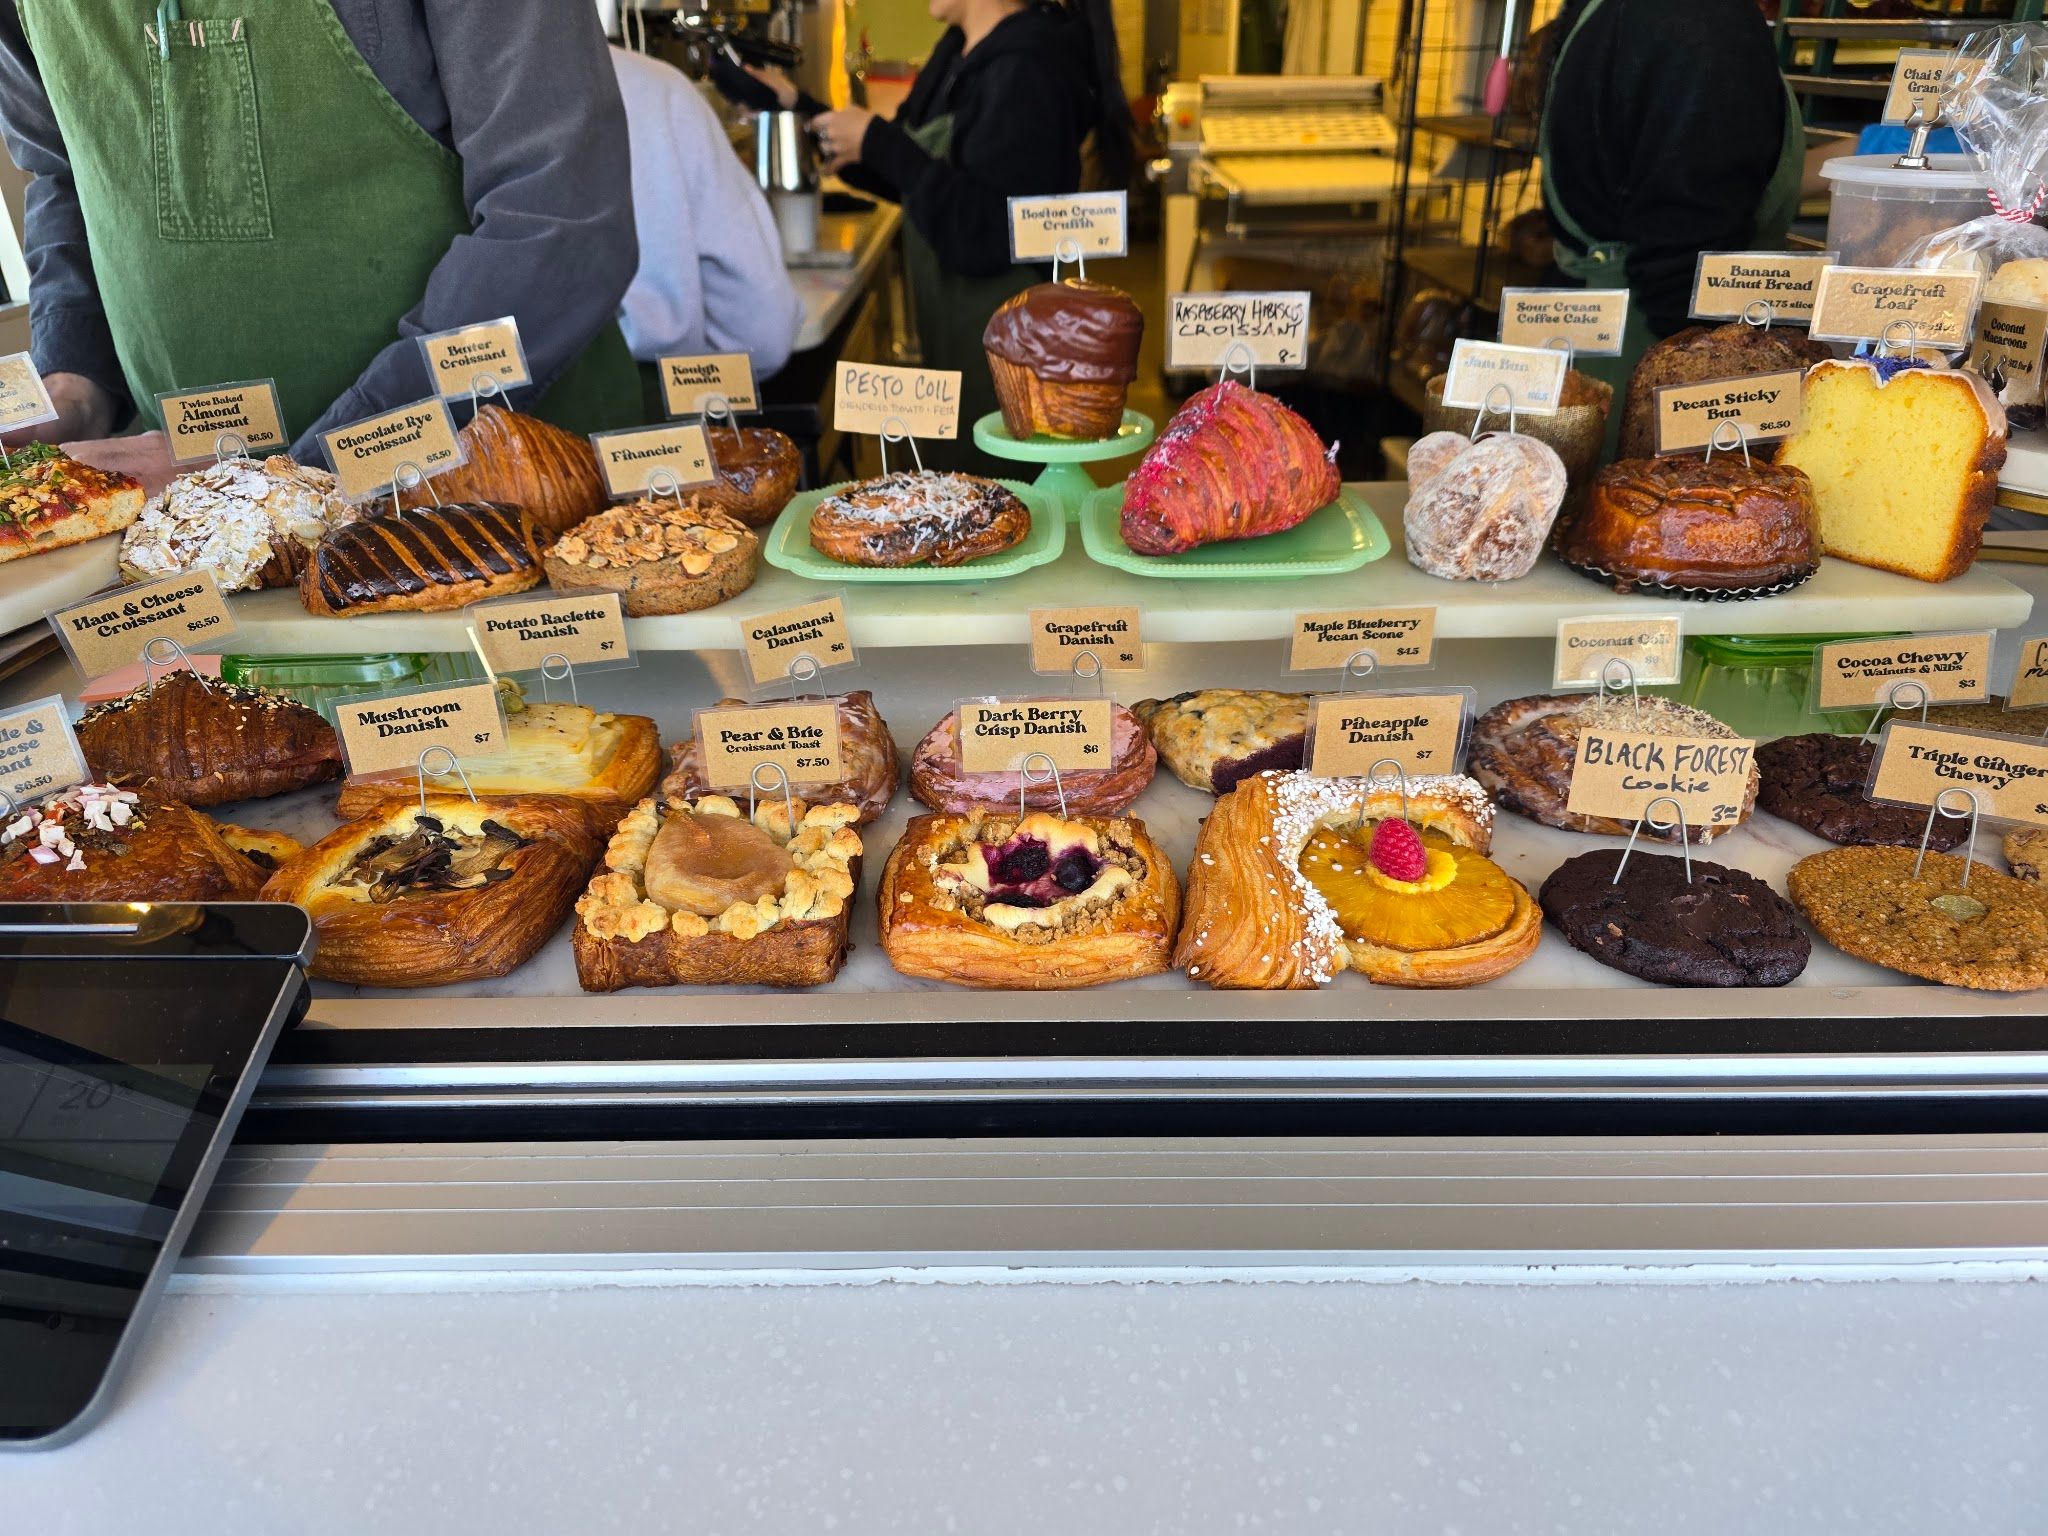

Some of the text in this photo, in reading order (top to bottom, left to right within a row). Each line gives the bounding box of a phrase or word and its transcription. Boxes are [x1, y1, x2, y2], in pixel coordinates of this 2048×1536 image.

[1903, 68, 1932, 80] Chai
[1021, 205, 1117, 220] Boston Cream
[1043, 218, 1094, 231] Cruffin
[1730, 264, 1791, 278] Banana
[1706, 276, 1813, 292] Walnut Bread
[1850, 281, 1947, 299] Grapefruit
[1516, 302, 1602, 313] Sour Cream
[1789, 301, 1814, 309] slice
[1874, 297, 1918, 311] Loaf
[1517, 313, 1599, 324] Coffee Cake
[1990, 318, 2026, 335] Coconut
[1179, 319, 1303, 339] CROISSANT
[1983, 329, 2029, 350] Macaroons
[447, 340, 492, 357] Butter
[440, 348, 507, 370] Croissant
[672, 376, 721, 386] Amann
[845, 369, 953, 402] PESTO COIL
[179, 394, 244, 410] Twice Baked
[1673, 388, 1781, 413] Pecan Sticky
[183, 403, 240, 422] Almond
[1707, 407, 1741, 420] Bun
[178, 416, 249, 435] Croissant
[336, 412, 433, 451] Chocolate Rye
[1759, 419, 1791, 431] $6.50
[247, 432, 273, 443] $6.50
[354, 428, 423, 459] Croissant
[426, 449, 452, 464] $5.50
[611, 444, 683, 464] Financier
[693, 459, 705, 468] $7
[72, 584, 204, 631] Ham & Cheese
[97, 602, 187, 637] Croissant
[187, 615, 221, 632] $6.50
[486, 608, 606, 632] Potato Raclette
[752, 612, 835, 641] Calamansi
[1045, 619, 1129, 635] Grapefruit
[1303, 618, 1421, 634] Maple Blueberry
[518, 624, 580, 641] Danish
[767, 628, 824, 650] Danish
[1059, 633, 1115, 646] Danish
[1317, 629, 1404, 642] Pecan Scone
[600, 641, 614, 651] $7
[830, 643, 845, 653] $6
[1568, 635, 1634, 648] Coconut
[1120, 653, 1133, 662] $6
[1837, 651, 1969, 669] Cocoa Chewy
[1842, 662, 1963, 679] w/ Walnuts & Nibs
[1958, 679, 1977, 689] $3
[357, 702, 462, 726] Mushroom
[978, 708, 1083, 723] Dark Berry
[25, 719, 45, 735] &
[378, 717, 449, 738] Danish
[975, 721, 1087, 739] Crisp Danish
[1340, 715, 1429, 731] Pineapple
[474, 732, 491, 744] $7
[720, 725, 823, 743] Pear & Brie
[1348, 730, 1414, 744] Danish
[726, 739, 821, 754] Croissant Toast
[1083, 744, 1099, 754] $6
[1416, 750, 1433, 759] $7
[796, 757, 830, 768] $7.50
[1584, 736, 1751, 777] BLACK FOREST
[1908, 745, 2048, 779] Triple Ginger
[14, 775, 53, 794] $6.50
[1934, 764, 2014, 791] Chewy
